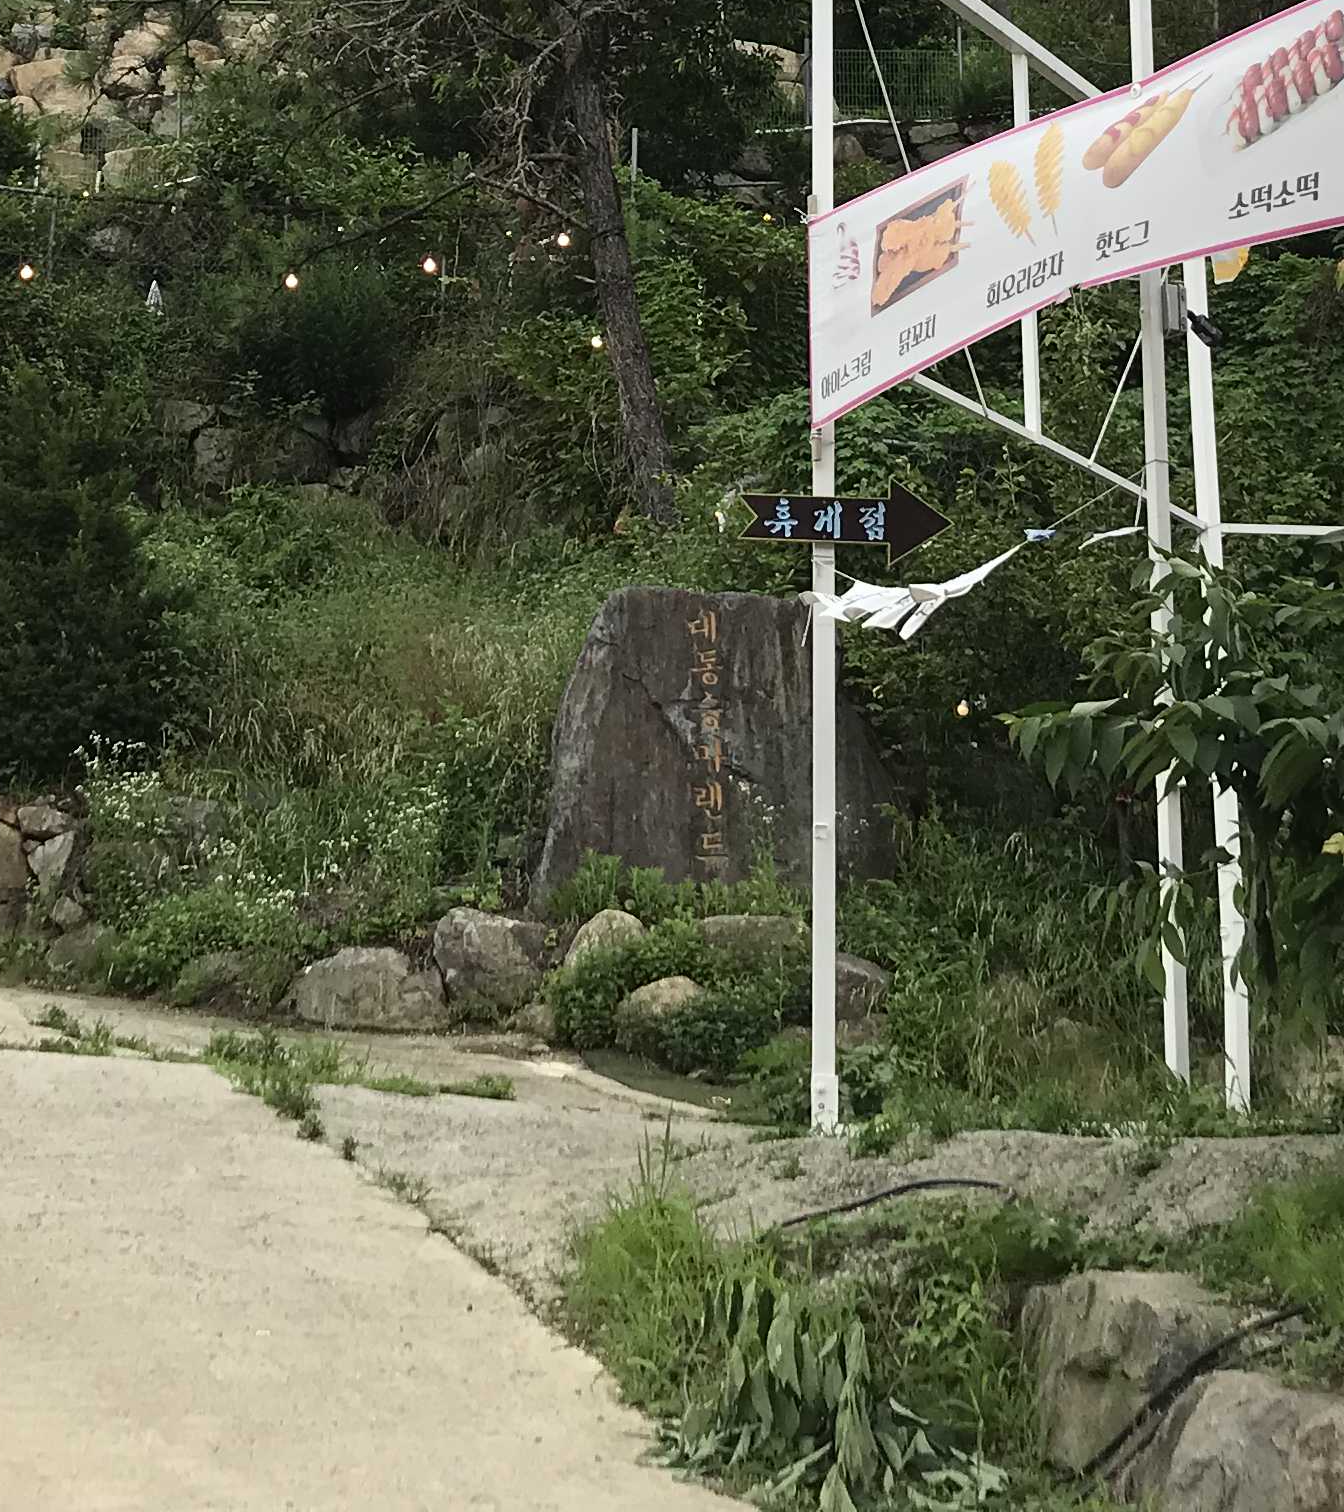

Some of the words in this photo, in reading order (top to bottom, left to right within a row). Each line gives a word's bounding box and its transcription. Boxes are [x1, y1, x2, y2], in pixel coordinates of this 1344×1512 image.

[1227, 171, 1320, 220] 소떡소떡
[1094, 220, 1151, 262] 핫도그
[984, 251, 1065, 309] 회오리감자
[898, 313, 937, 356] 닭꼬치
[821, 348, 872, 400] 아이스크림
